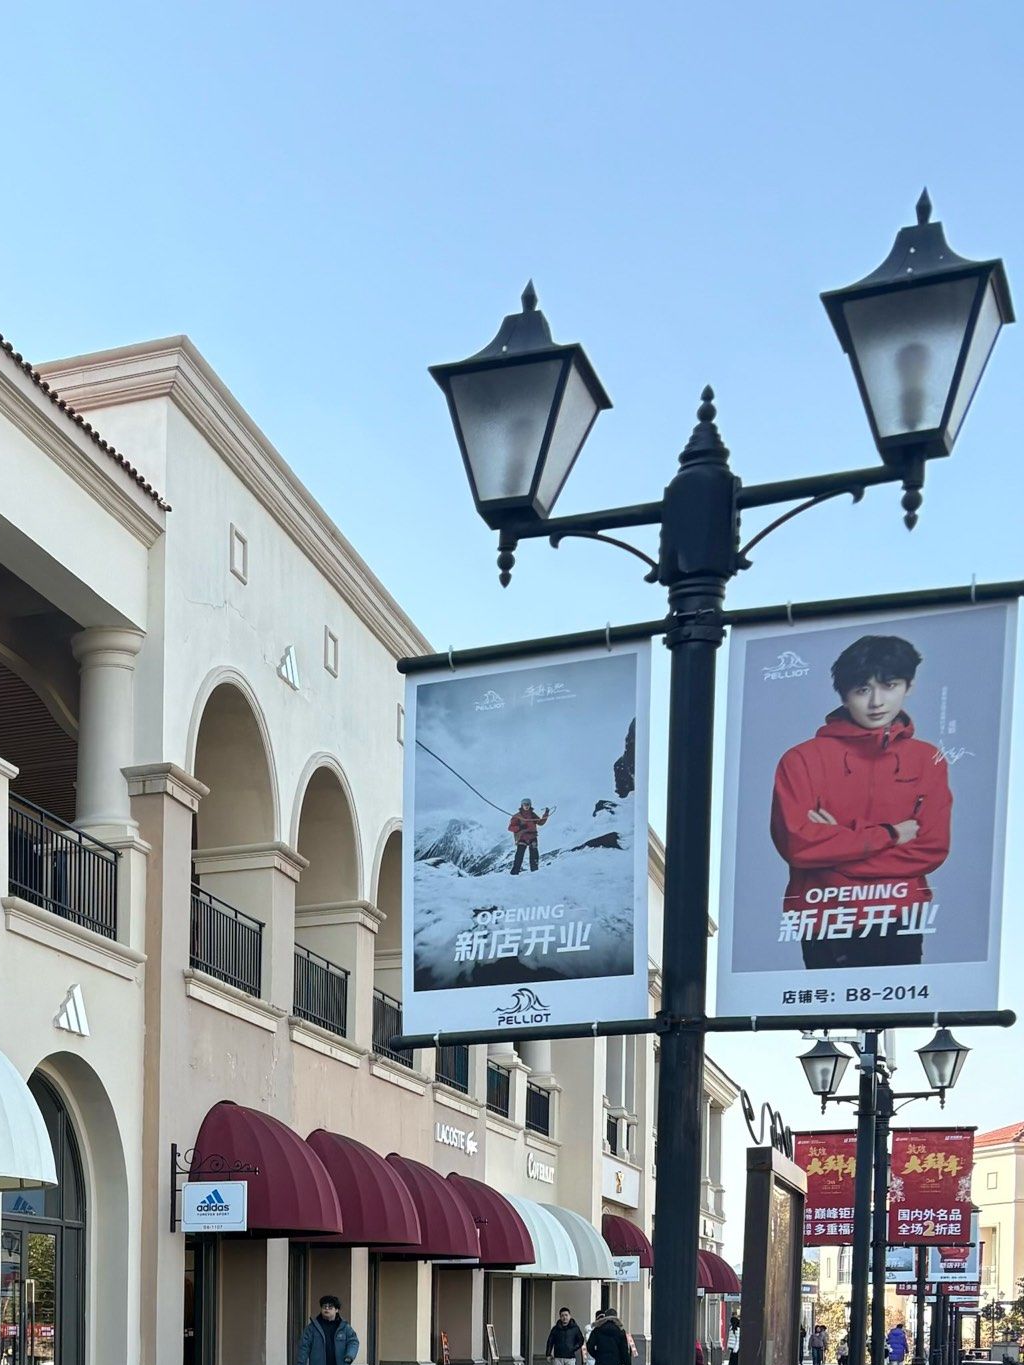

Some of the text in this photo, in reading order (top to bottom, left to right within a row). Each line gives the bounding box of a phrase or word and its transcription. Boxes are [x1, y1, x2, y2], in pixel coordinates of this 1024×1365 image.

[763, 668, 810, 681] PELLIOT
[805, 882, 909, 904] OPENING
[476, 904, 564, 925] OPENING
[777, 902, 940, 942] 新店开业
[454, 920, 592, 962] 新店开业
[846, 985, 929, 1002] B8-2014
[498, 1013, 551, 1026] PELLIOT
[435, 1121, 466, 1150] LACOSTE
[196, 1203, 230, 1212] adidas
[897, 1208, 962, 1221] 国内外名品
[897, 1220, 961, 1237] 全场2折起
